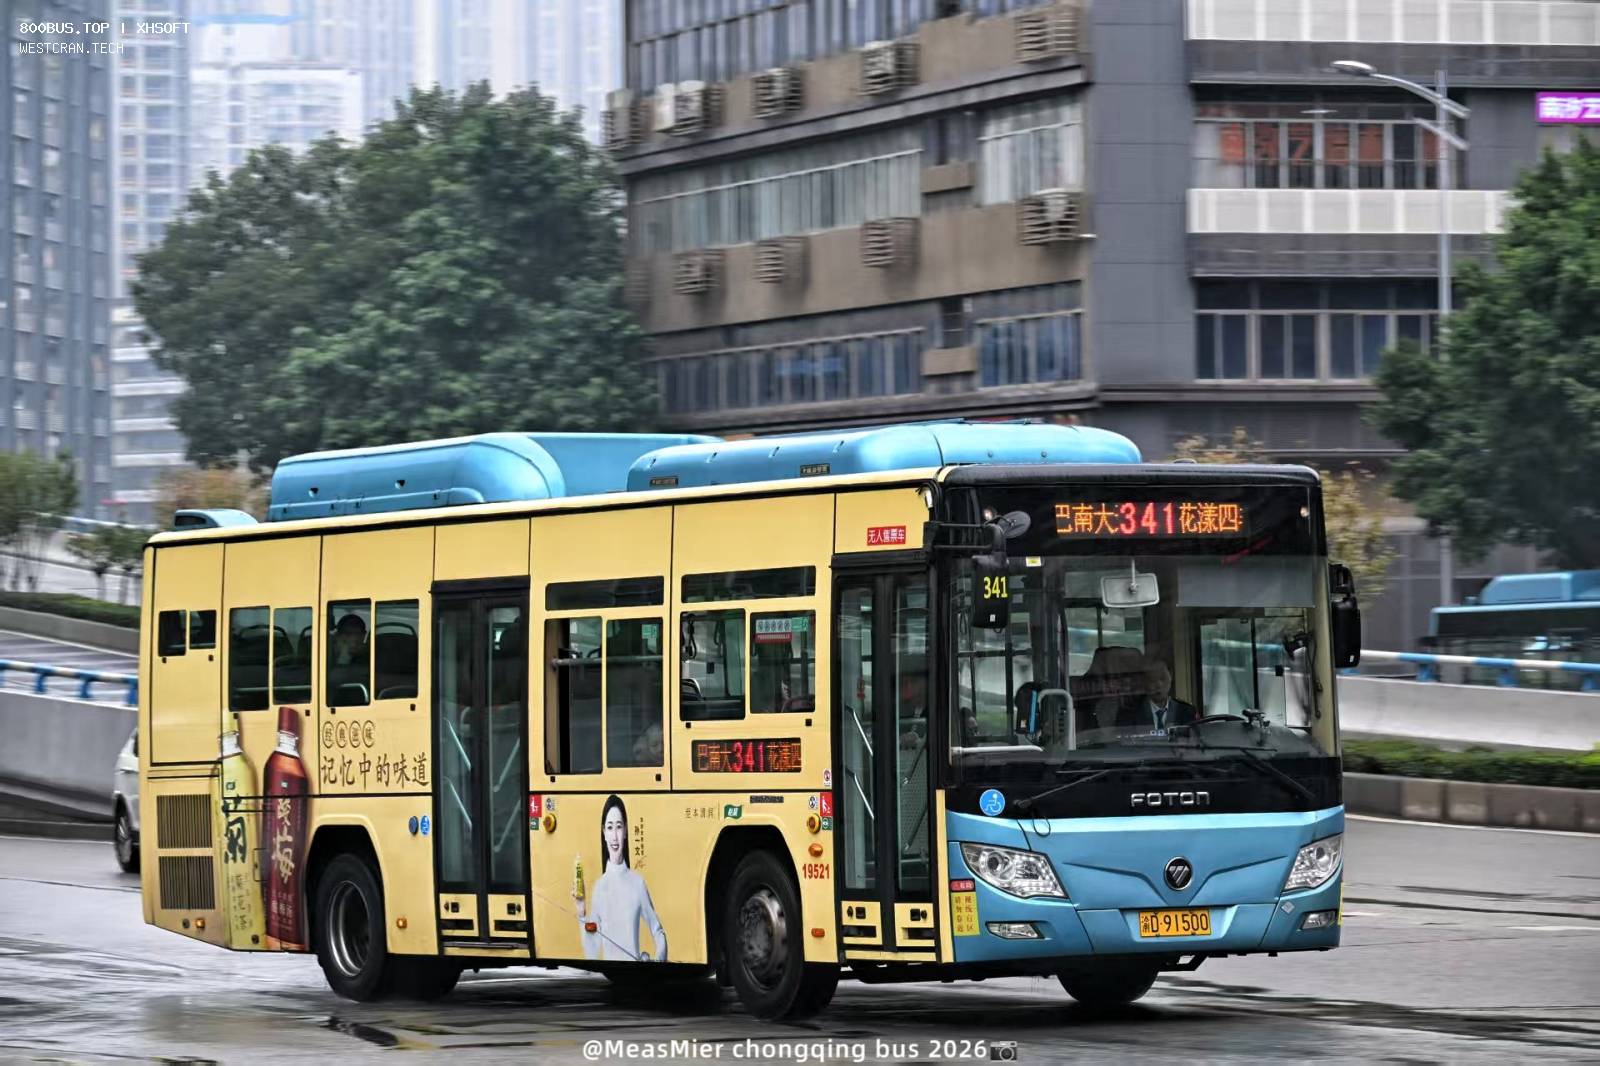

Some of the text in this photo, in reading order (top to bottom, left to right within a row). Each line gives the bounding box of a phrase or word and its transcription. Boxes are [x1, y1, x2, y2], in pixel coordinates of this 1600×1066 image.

[868, 528, 905, 543] 无人售票车
[983, 576, 1009, 599] 341
[321, 752, 429, 790] 记忆中的味道
[1130, 791, 1210, 807] FOTON
[802, 863, 830, 879] 19521
